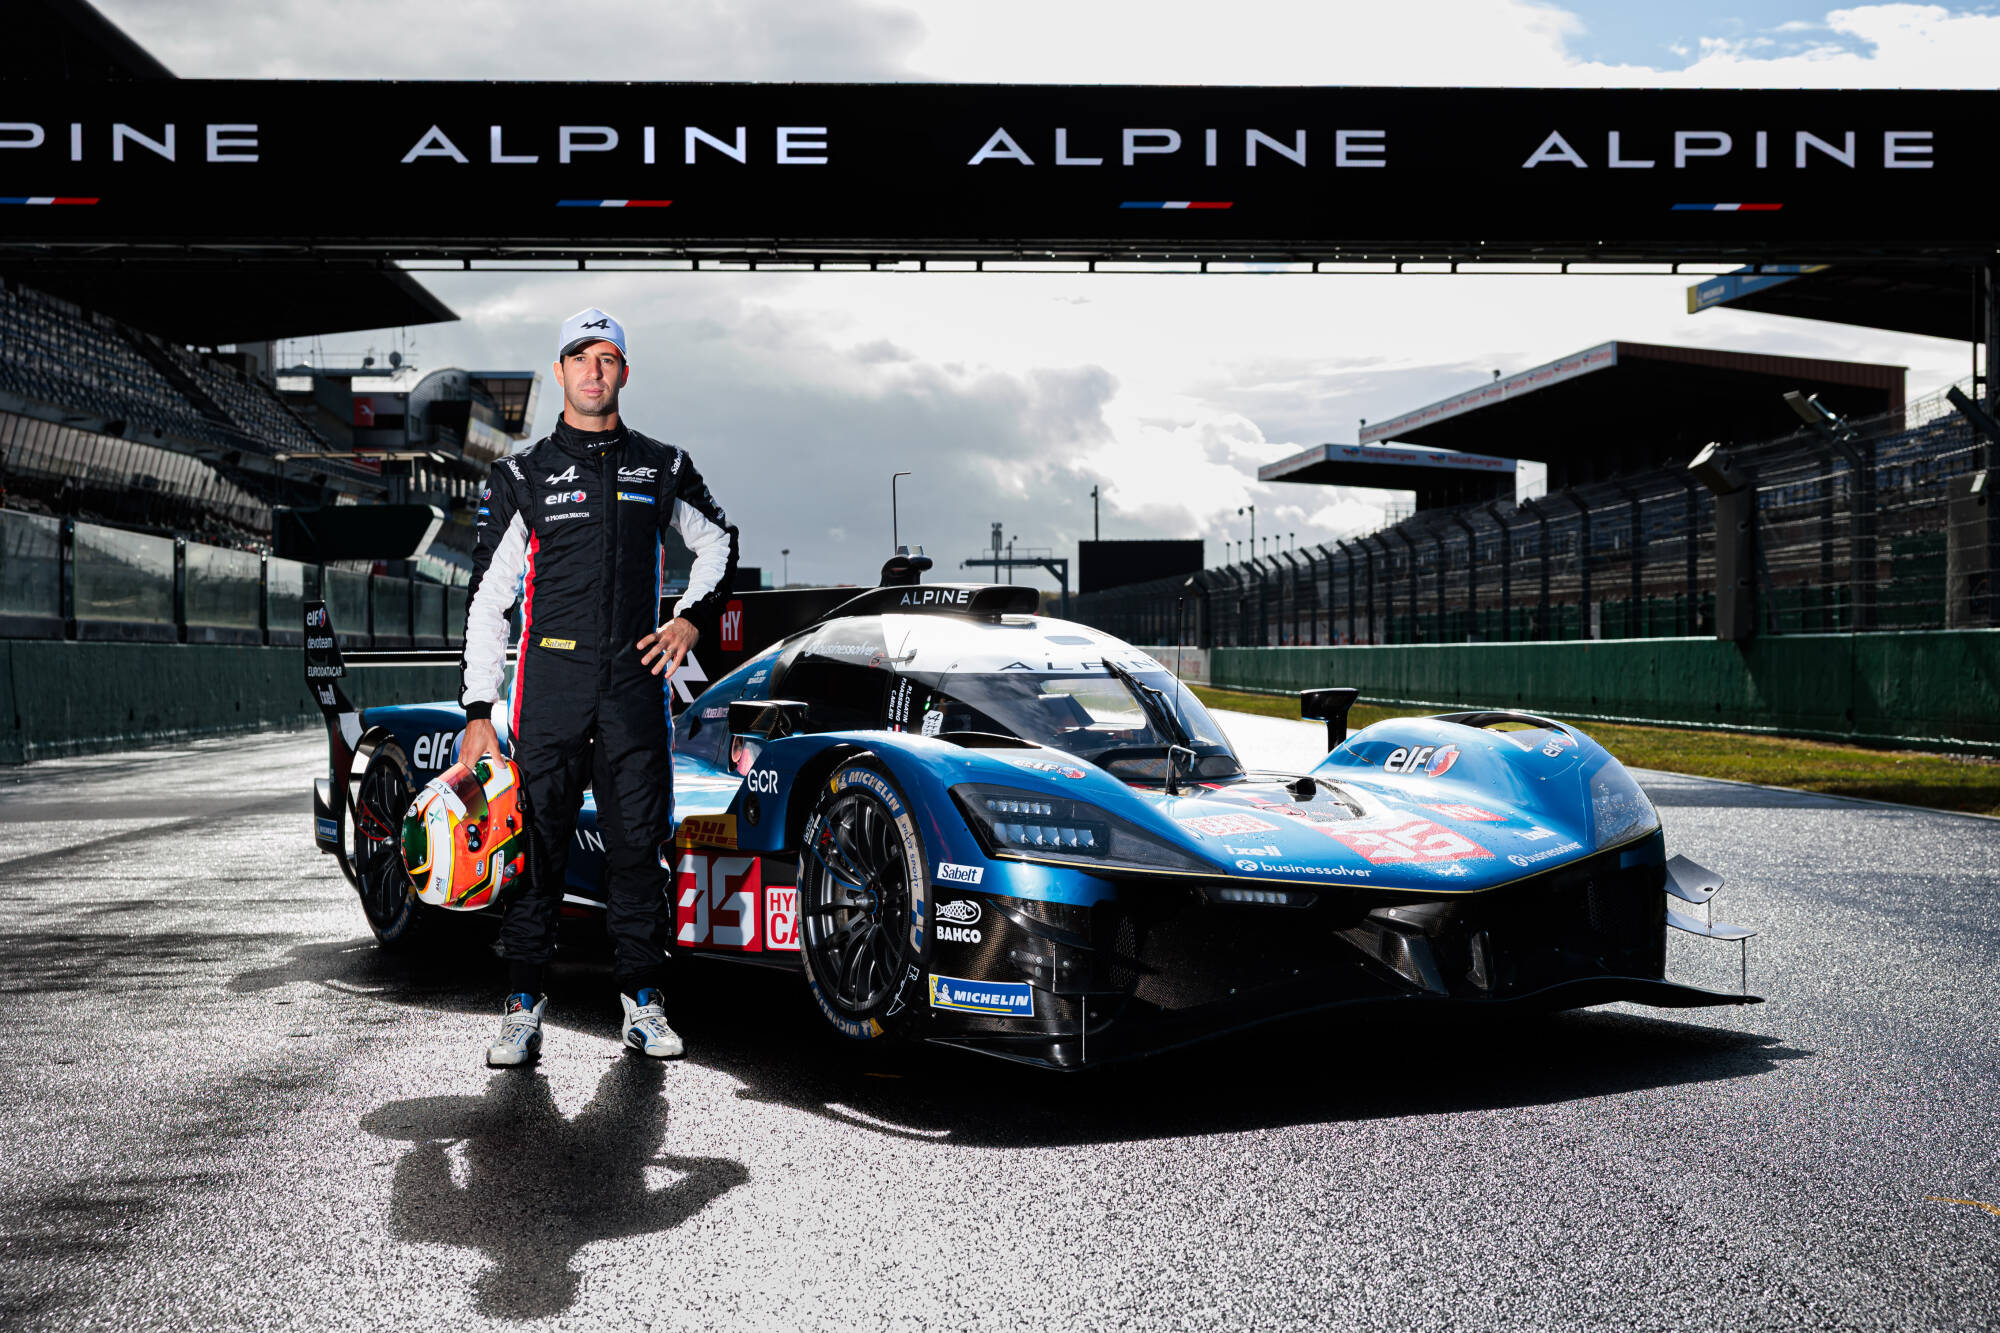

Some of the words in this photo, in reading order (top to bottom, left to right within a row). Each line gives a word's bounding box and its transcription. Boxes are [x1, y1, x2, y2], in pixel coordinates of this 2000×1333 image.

[401, 125, 829, 165] ALPINE
[967, 128, 1387, 167] ALPINE
[1522, 130, 1934, 169] ALPINE
[617, 466, 658, 478] WEC
[545, 492, 571, 505] elf
[900, 589, 970, 606] ALPINE
[306, 609, 319, 626] elf
[722, 611, 741, 641] HY
[307, 635, 333, 649] devoteam
[307, 665, 343, 677] EURODATACAR
[413, 732, 454, 770] elf
[1541, 740, 1565, 758] elf
[1384, 745, 1434, 775] elf
[747, 769, 779, 794] GCR
[847, 771, 901, 812] MICHELIN
[685, 819, 729, 845] DHL
[1223, 844, 1283, 857] ixell
[1519, 841, 1583, 863] businessolver
[941, 864, 978, 882] Sabelt
[1260, 861, 1372, 878] businessolver
[676, 854, 755, 946] 35
[936, 925, 982, 943] BAHCO
[953, 990, 1029, 1007] MICHELIN
